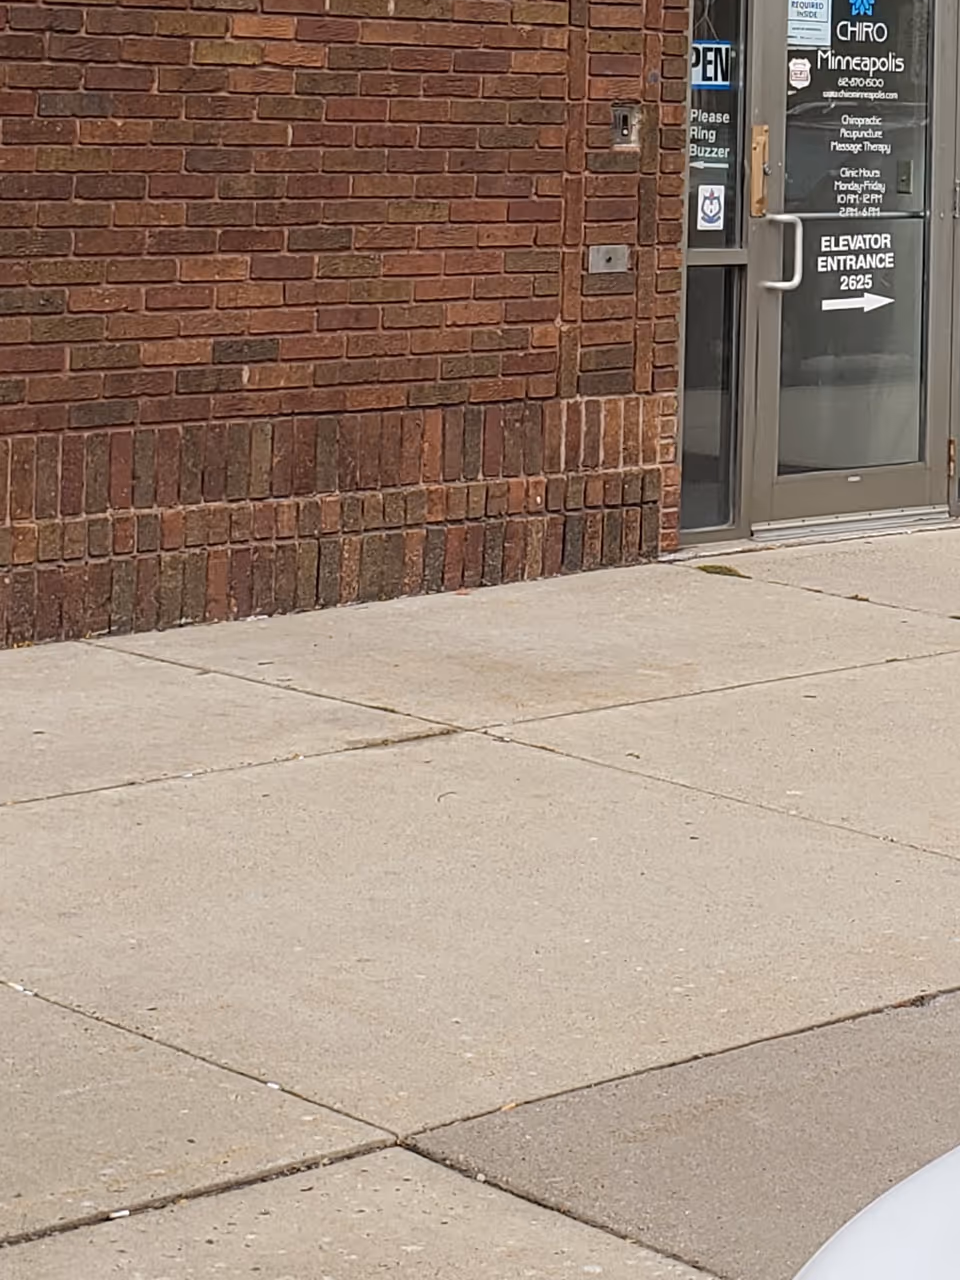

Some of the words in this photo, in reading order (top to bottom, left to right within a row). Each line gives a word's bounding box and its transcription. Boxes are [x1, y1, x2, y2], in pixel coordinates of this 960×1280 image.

[791, 0, 824, 10] REQUIRED
[796, 10, 819, 19] INSIDE
[836, 21, 888, 43] CHIRO
[691, 46, 731, 83] PEN
[817, 49, 905, 78] Minneapolis
[690, 108, 730, 125] Please
[841, 114, 883, 128] Chiropractic
[690, 125, 717, 143] Ring
[840, 127, 883, 141] Acupuncture
[689, 143, 730, 158] Buzzer
[830, 140, 862, 154] Massage
[862, 140, 892, 155] Therapy
[840, 167, 858, 178] Clinic
[821, 234, 891, 252] ELEVATOR
[817, 253, 895, 272] ENTRANCE
[840, 274, 873, 290] 2625
